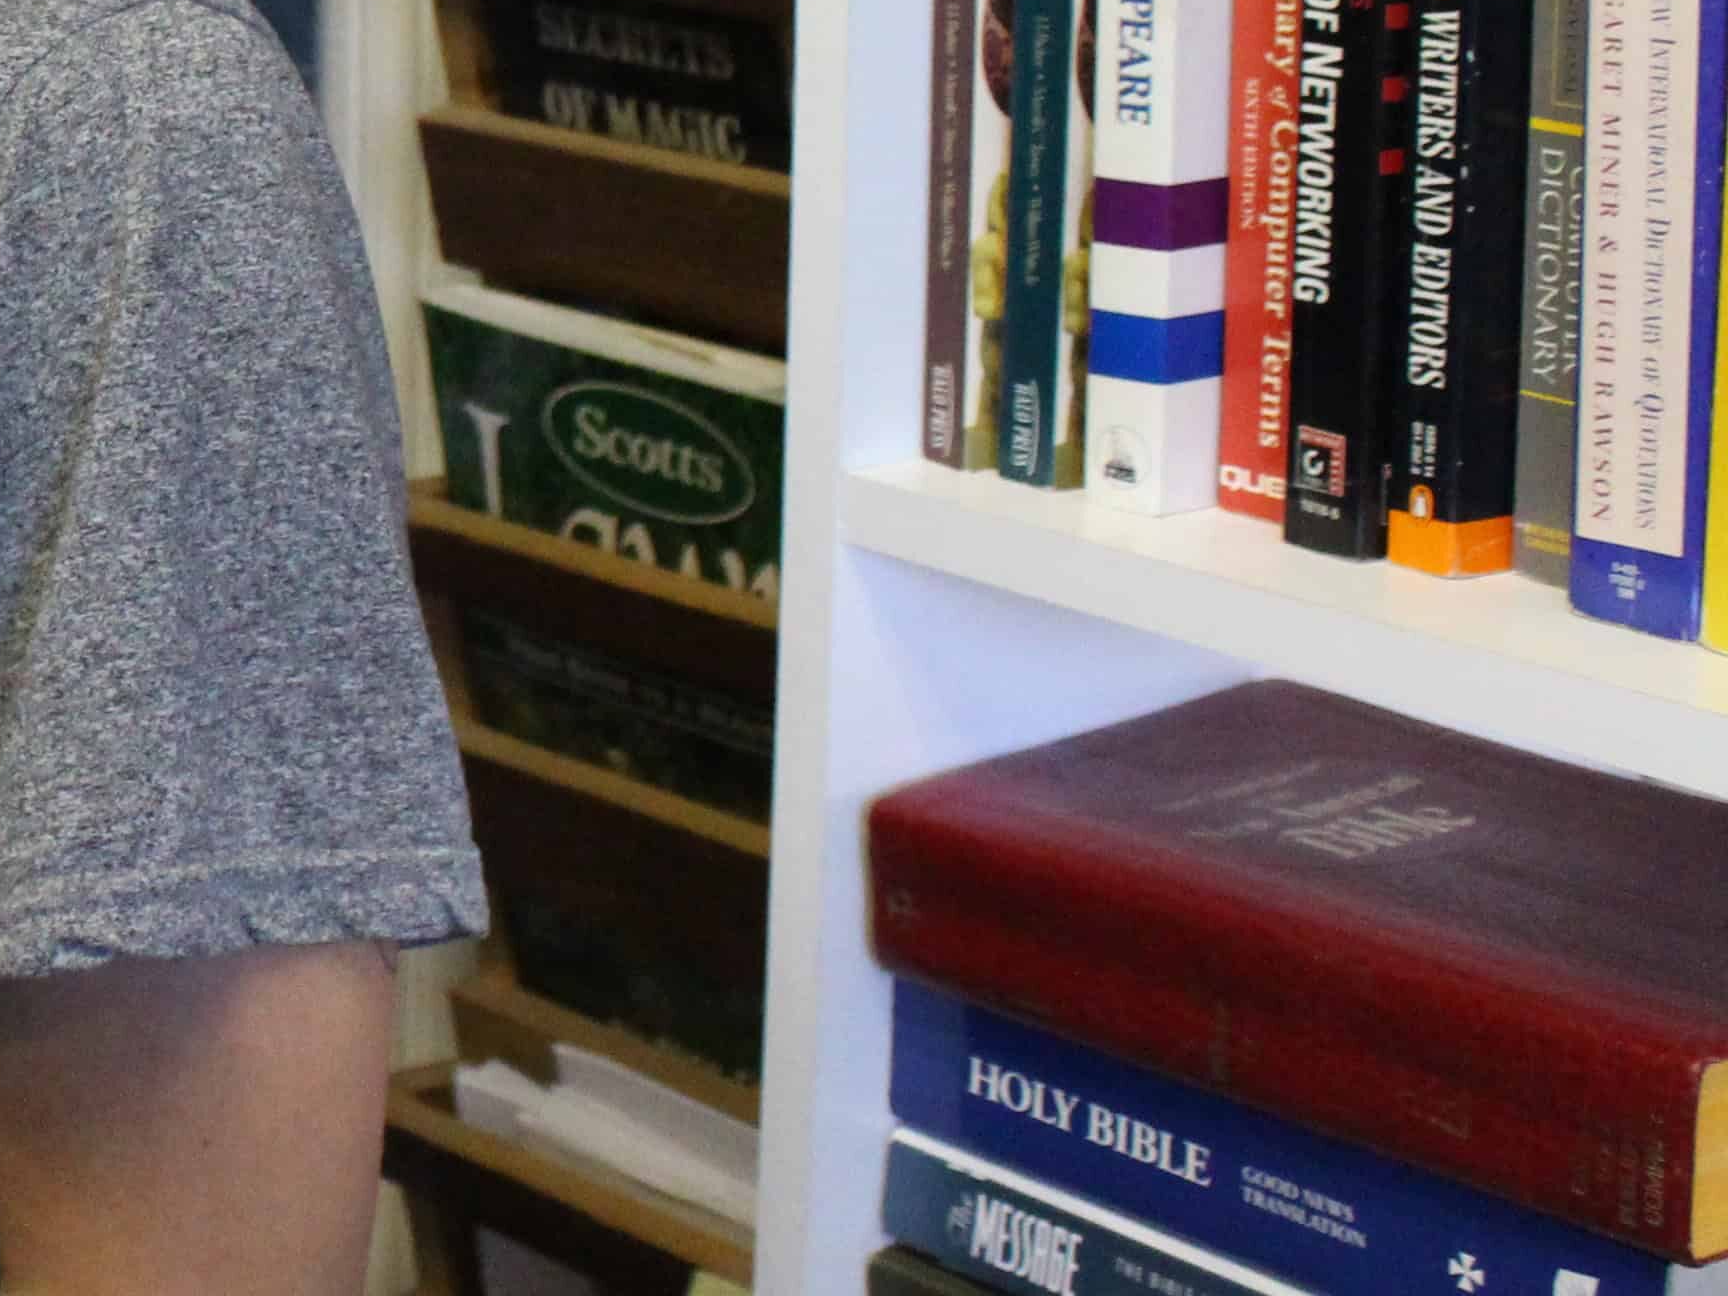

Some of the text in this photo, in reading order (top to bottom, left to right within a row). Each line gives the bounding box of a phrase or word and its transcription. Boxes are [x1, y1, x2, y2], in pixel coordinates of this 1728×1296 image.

[537, 4, 736, 82] SECRETS
[1413, 10, 1460, 158] WRITERS
[543, 80, 747, 162] OF MAGIC
[1269, 84, 1293, 108] of
[1646, 36, 1681, 206] INTERNATIONAL
[1294, 42, 1344, 305] NETWORKING
[1412, 163, 1454, 234] AND
[1597, 113, 1622, 218] MINER
[1257, 119, 1294, 314] Computer
[1529, 147, 1567, 384] DICTIONARY
[1597, 234, 1619, 253] &
[1407, 241, 1453, 389] EDITORS
[1594, 272, 1618, 365] HUGH
[1641, 216, 1677, 348] DICTIONARY
[1013, 383, 1035, 424] HALO
[1258, 330, 1292, 448] Terms
[1641, 355, 1665, 386] OF
[575, 404, 724, 493] Scotts
[1011, 425, 1033, 468] PRESS
[1590, 381, 1617, 522] RAWSON
[1634, 393, 1665, 529] QUOTATIONS
[967, 1056, 1213, 1187] HOLY BIBLE
[1241, 1164, 1357, 1224] GOOD NEWS
[1243, 1185, 1367, 1249] TRANSLATION
